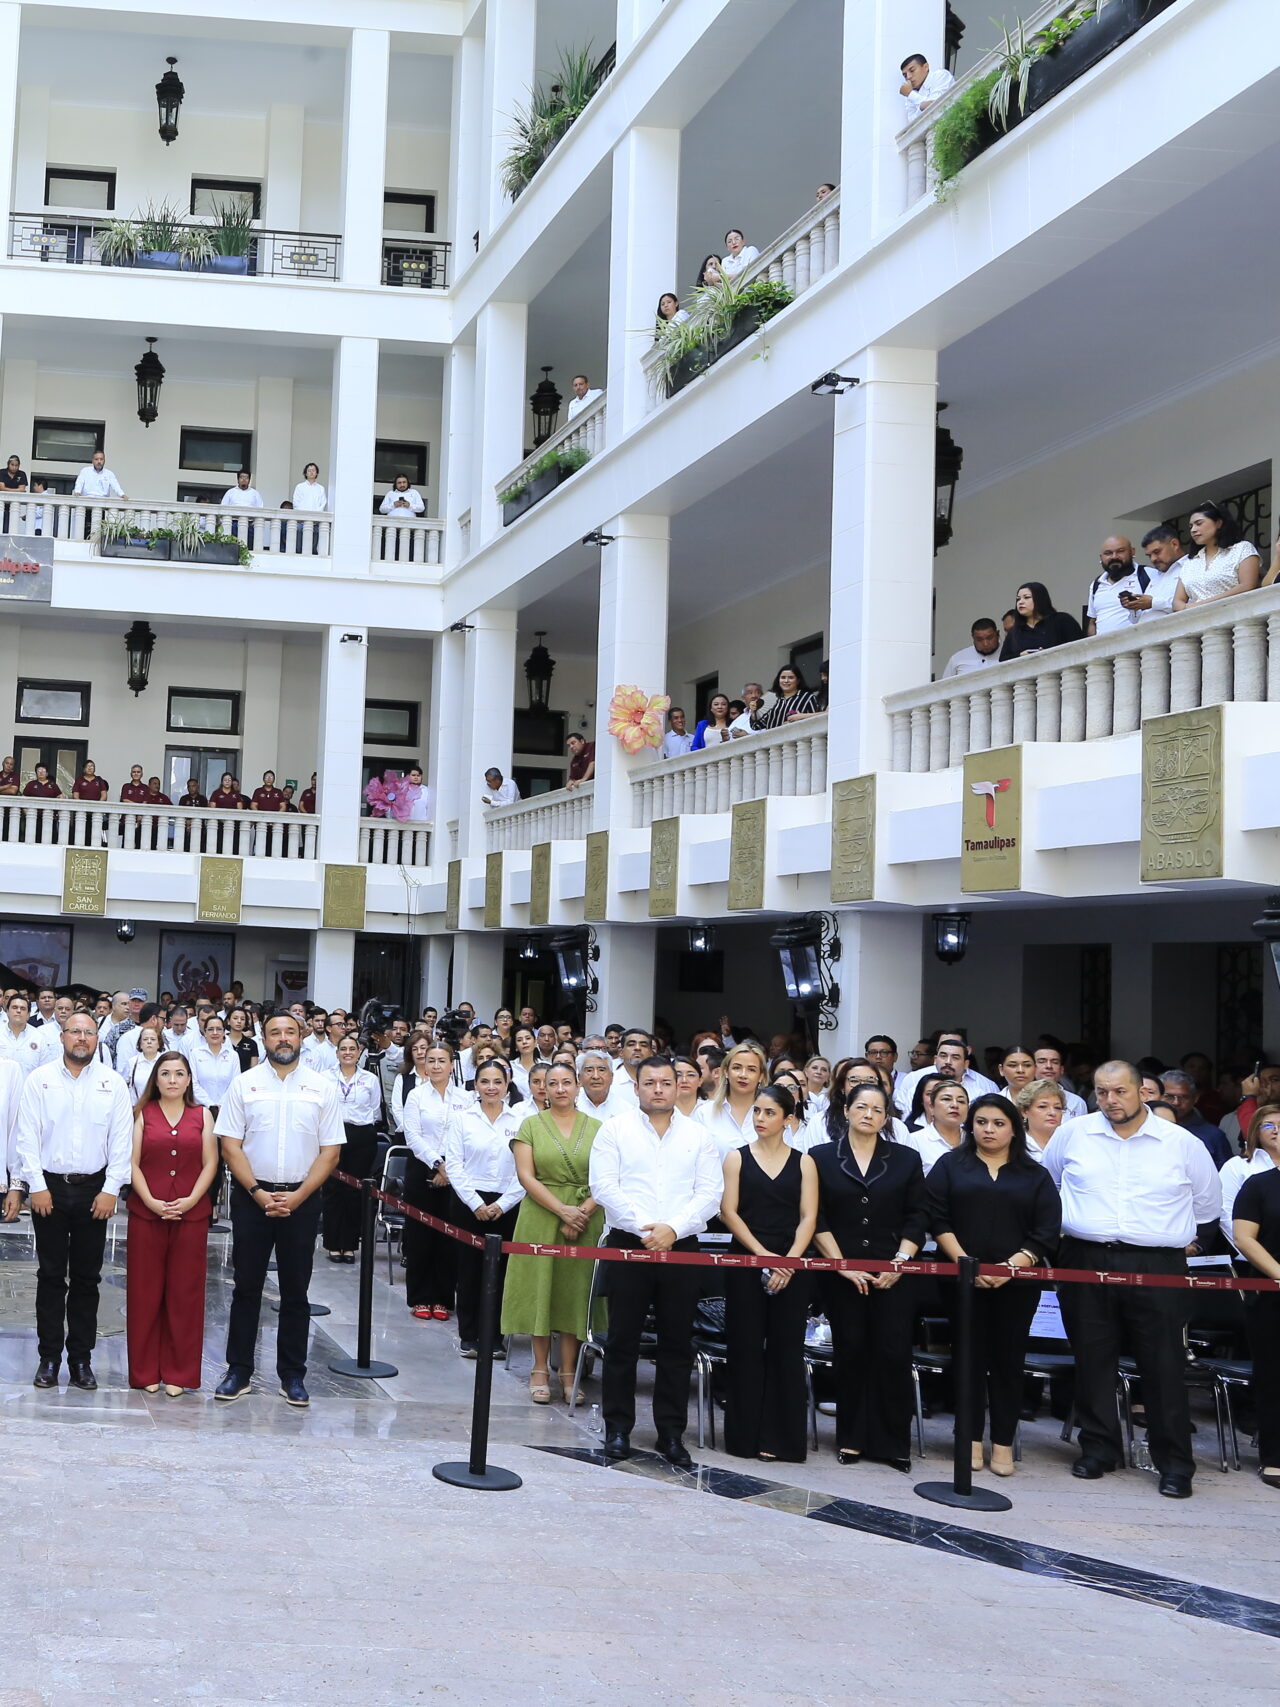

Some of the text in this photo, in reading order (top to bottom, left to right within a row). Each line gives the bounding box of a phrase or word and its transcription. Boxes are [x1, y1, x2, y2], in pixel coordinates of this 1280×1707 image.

[964, 836, 1017, 853] Tamaulipas
[1146, 848, 1214, 871] ABASOLO
[76, 896, 93, 904] SAN
[68, 903, 99, 911] CARLOS
[201, 911, 237, 919] FERNANDO
